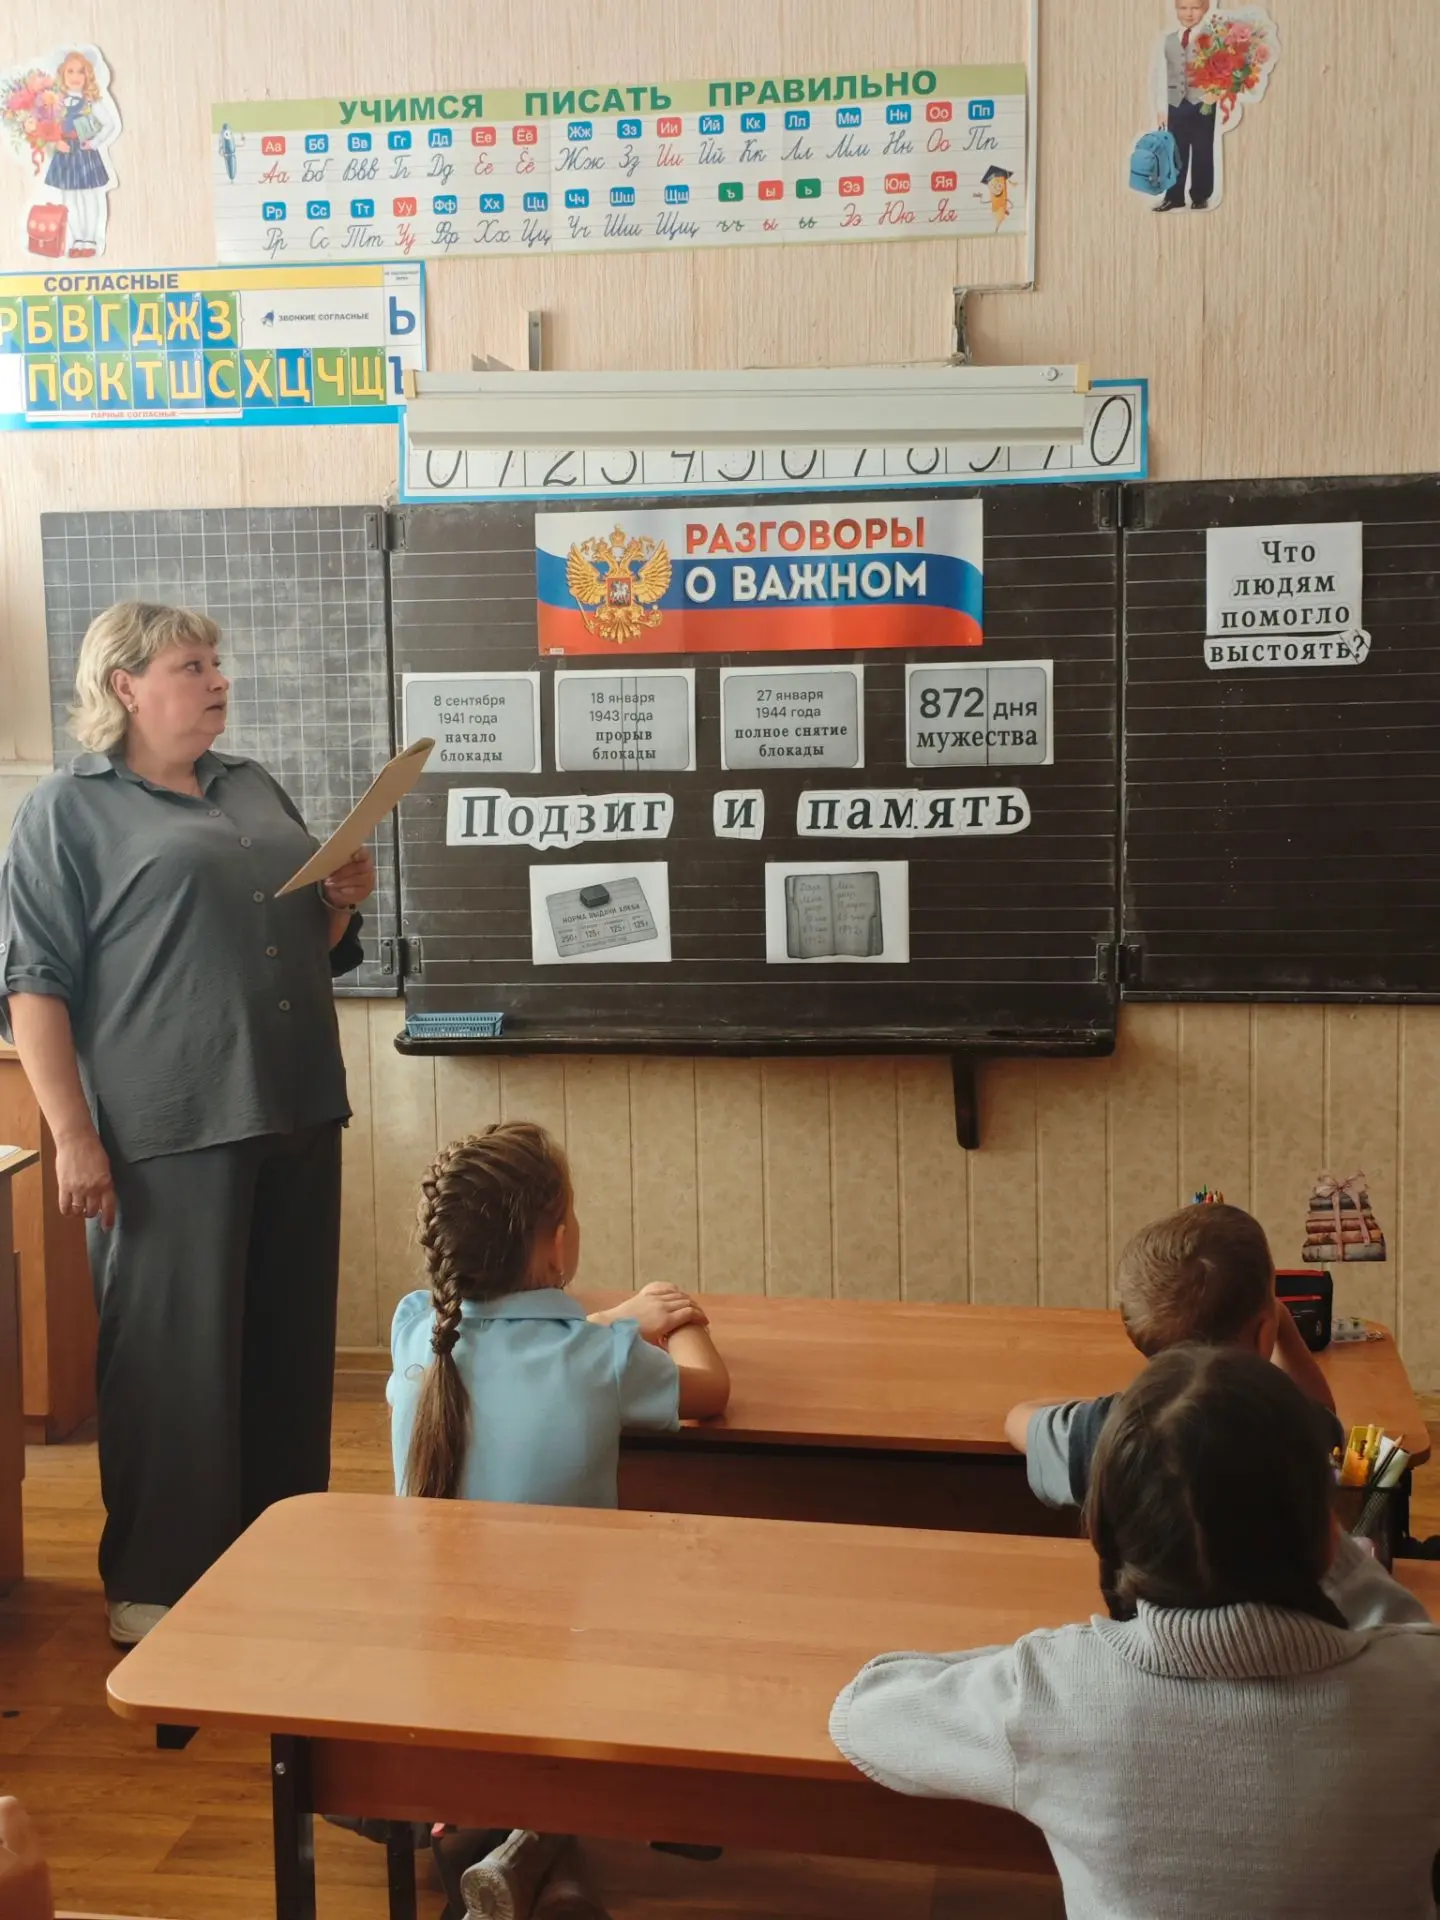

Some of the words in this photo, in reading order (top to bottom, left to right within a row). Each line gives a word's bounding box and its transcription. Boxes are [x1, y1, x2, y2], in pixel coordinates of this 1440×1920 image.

[339, 94, 483, 125] УЧИМСЯ
[524, 87, 672, 116] ПИСАТЬ
[709, 70, 937, 107] ПРАВИЛЬНО
[266, 140, 281, 152] Аа
[309, 138, 324, 150] Бб
[352, 138, 367, 149] Вв
[394, 135, 406, 146] Гг
[431, 132, 449, 146] Дд
[476, 131, 492, 143] Ее
[517, 129, 533, 142] Ёё
[569, 126, 591, 139] Жж
[622, 124, 637, 135] Зз
[661, 123, 678, 135] Ии
[703, 118, 720, 131] Йй
[746, 118, 761, 129] Кк
[788, 115, 806, 127] Лл
[839, 113, 859, 125] Мм
[890, 109, 907, 120] Нн
[930, 107, 948, 119] Оо
[973, 105, 990, 116] Пп
[258, 161, 290, 184] Аа
[301, 159, 334, 182] Бб
[427, 154, 455, 185] Дд
[474, 152, 494, 175] Ее
[555, 147, 605, 171] Жж
[619, 144, 642, 177] Зз
[657, 143, 683, 167] Ии
[698, 137, 725, 165] Йй
[739, 139, 767, 163] Кк
[781, 136, 814, 161] Лл
[826, 134, 870, 158] Мм
[883, 130, 914, 155] Нн
[963, 125, 999, 151] Пп
[266, 206, 282, 220] Рр
[356, 203, 369, 215] Тт
[397, 202, 412, 216] Уу
[434, 200, 456, 213] Фф
[527, 197, 544, 210] Цц
[569, 194, 585, 205] Чч
[611, 191, 634, 204] Шш
[843, 181, 860, 193] Ээ
[886, 177, 909, 190] Юю
[936, 176, 953, 188] Яя
[263, 228, 288, 259] Рр
[395, 223, 416, 255] Уу
[431, 221, 460, 252] Фф
[521, 218, 552, 248] Цц
[568, 215, 591, 239] Чч
[603, 211, 641, 237] Шш
[656, 211, 700, 240] Щщ
[840, 203, 862, 227] Ээ
[878, 200, 916, 225] Юю
[929, 198, 957, 223] Яя
[44, 274, 179, 293] СОГЛАСНЫЕ
[27, 306, 53, 344] Б
[63, 305, 89, 343] В
[100, 304, 120, 341] Г
[133, 303, 162, 346] Д
[167, 301, 200, 340] Ж
[208, 300, 232, 340] З
[389, 296, 416, 335] Ь
[29, 363, 56, 401] П
[62, 362, 94, 401] Ф
[100, 362, 125, 401] К
[136, 361, 162, 399] Т
[170, 360, 201, 399] Ш
[280, 358, 310, 402] Ц
[318, 357, 344, 396] Ч
[351, 356, 384, 401] Щ
[686, 517, 924, 554] РАЗГОВОРЫ
[1262, 541, 1315, 563] Что
[685, 566, 716, 603] О
[732, 560, 927, 602] ВАЖНОМ
[1234, 575, 1335, 598] людям
[1221, 606, 1349, 628] помогло
[434, 696, 442, 706] 8
[446, 694, 506, 708] сентября
[591, 692, 604, 704] 18
[608, 693, 655, 706] января
[757, 690, 772, 701] 27
[776, 689, 824, 703] января
[920, 687, 984, 719] 872
[993, 701, 1037, 720] дня
[438, 713, 465, 724] 1941
[469, 714, 498, 726] года
[590, 710, 620, 722] 1943
[624, 711, 654, 722] года
[756, 707, 786, 719] 1944
[791, 707, 821, 719] года
[445, 732, 496, 743] начало
[596, 730, 652, 744] прорыв
[735, 726, 789, 739] полное
[795, 724, 848, 737] снятие
[917, 726, 1038, 753] мужества
[440, 750, 502, 762] блокады
[592, 747, 656, 762] блокады
[759, 744, 824, 758] блокады
[723, 799, 756, 829] и
[806, 795, 1025, 831] память
